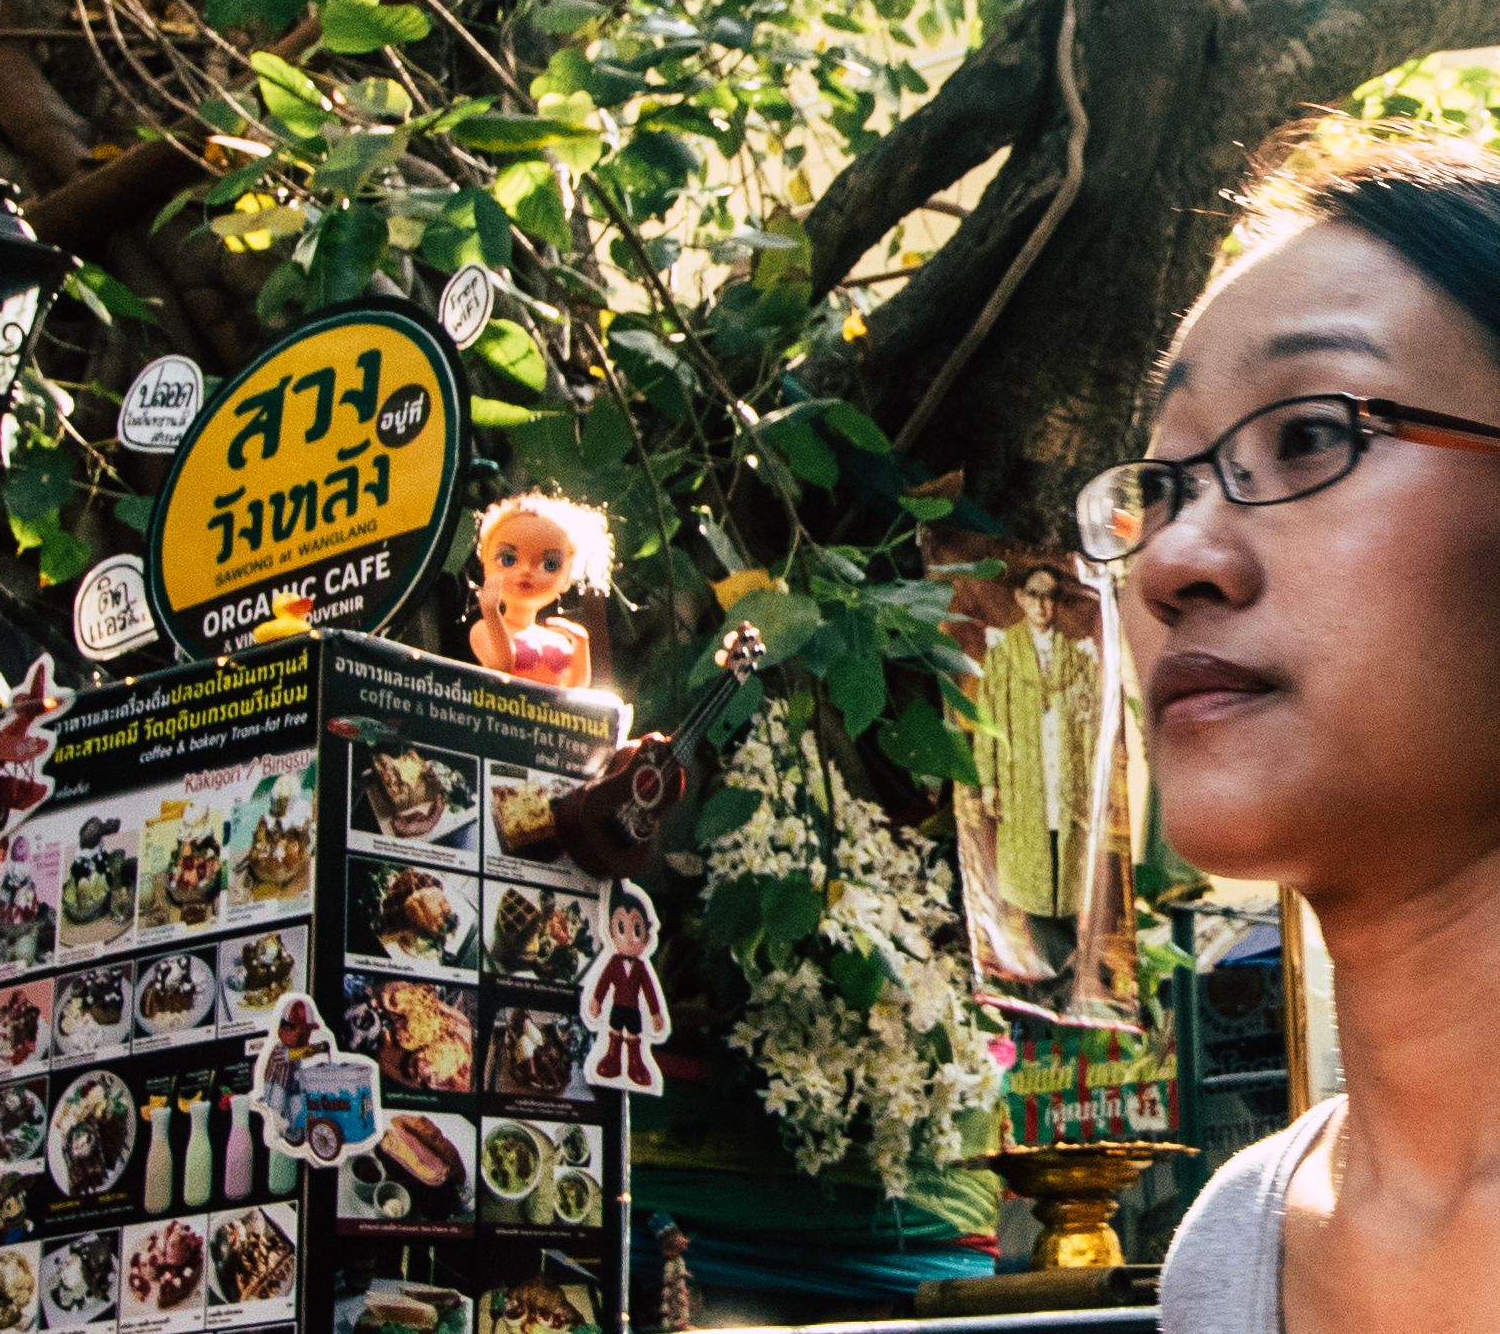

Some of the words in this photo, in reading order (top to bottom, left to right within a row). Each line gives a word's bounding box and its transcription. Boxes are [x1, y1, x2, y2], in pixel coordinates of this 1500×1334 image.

[227, 348, 383, 471] สวง
[207, 439, 391, 564] วังหลัง
[324, 540, 392, 596] CAFÉ
[298, 594, 365, 627] OUVENIR
[359, 686, 413, 717] coffee
[138, 743, 173, 765] coffee
[188, 731, 228, 753] bakery
